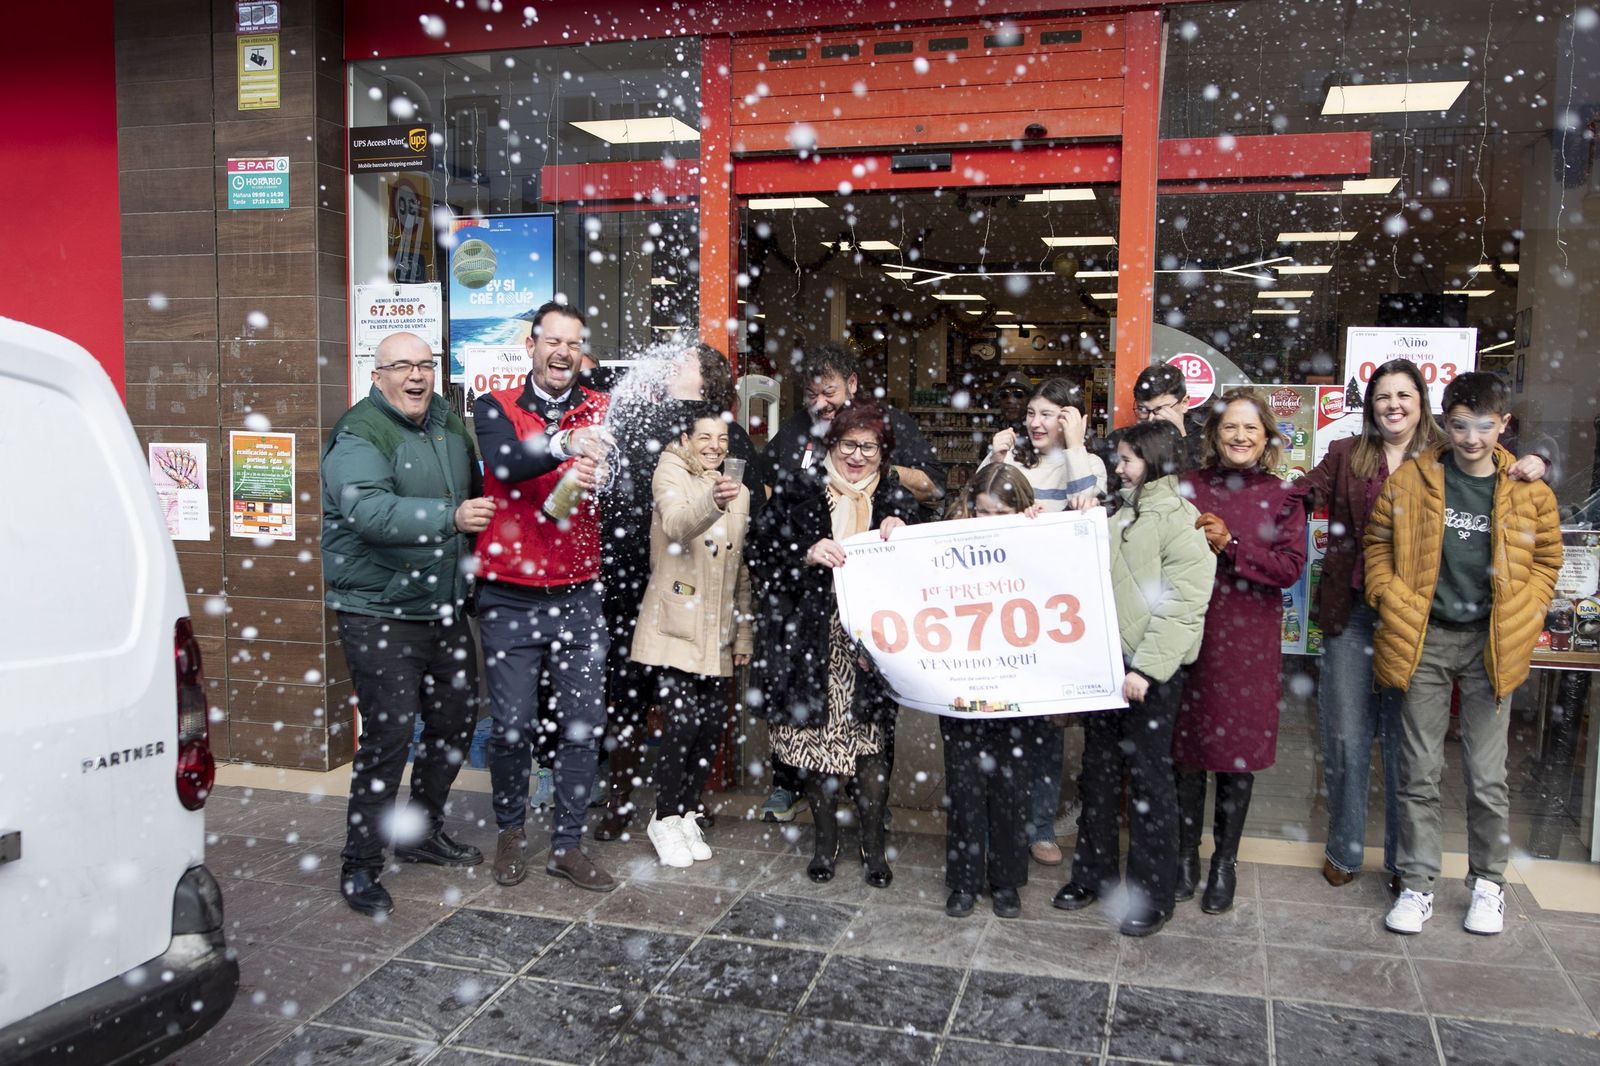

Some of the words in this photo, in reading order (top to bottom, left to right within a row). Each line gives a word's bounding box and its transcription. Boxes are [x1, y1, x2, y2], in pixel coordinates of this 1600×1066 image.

[367, 139, 387, 147] Access
[388, 138, 404, 146] Point
[411, 135, 426, 148] ups
[237, 161, 274, 170] SPAR
[246, 177, 282, 186] HORARIO
[503, 279, 515, 292] SI
[470, 292, 493, 305] CAE
[370, 304, 414, 316] 67.368
[1402, 337, 1428, 348] Niño
[503, 353, 522, 362] Niño
[1359, 361, 1457, 385] 003
[1268, 395, 1302, 408] Navidad
[1296, 434, 1303, 443] 3
[945, 544, 1006, 569] Niño
[945, 578, 1026, 600] PREMIO
[871, 593, 1086, 654] 06703
[917, 657, 992, 671] VENDIDO
[996, 651, 1038, 669] AQUÍ
[82, 741, 165, 774] PARTNER
